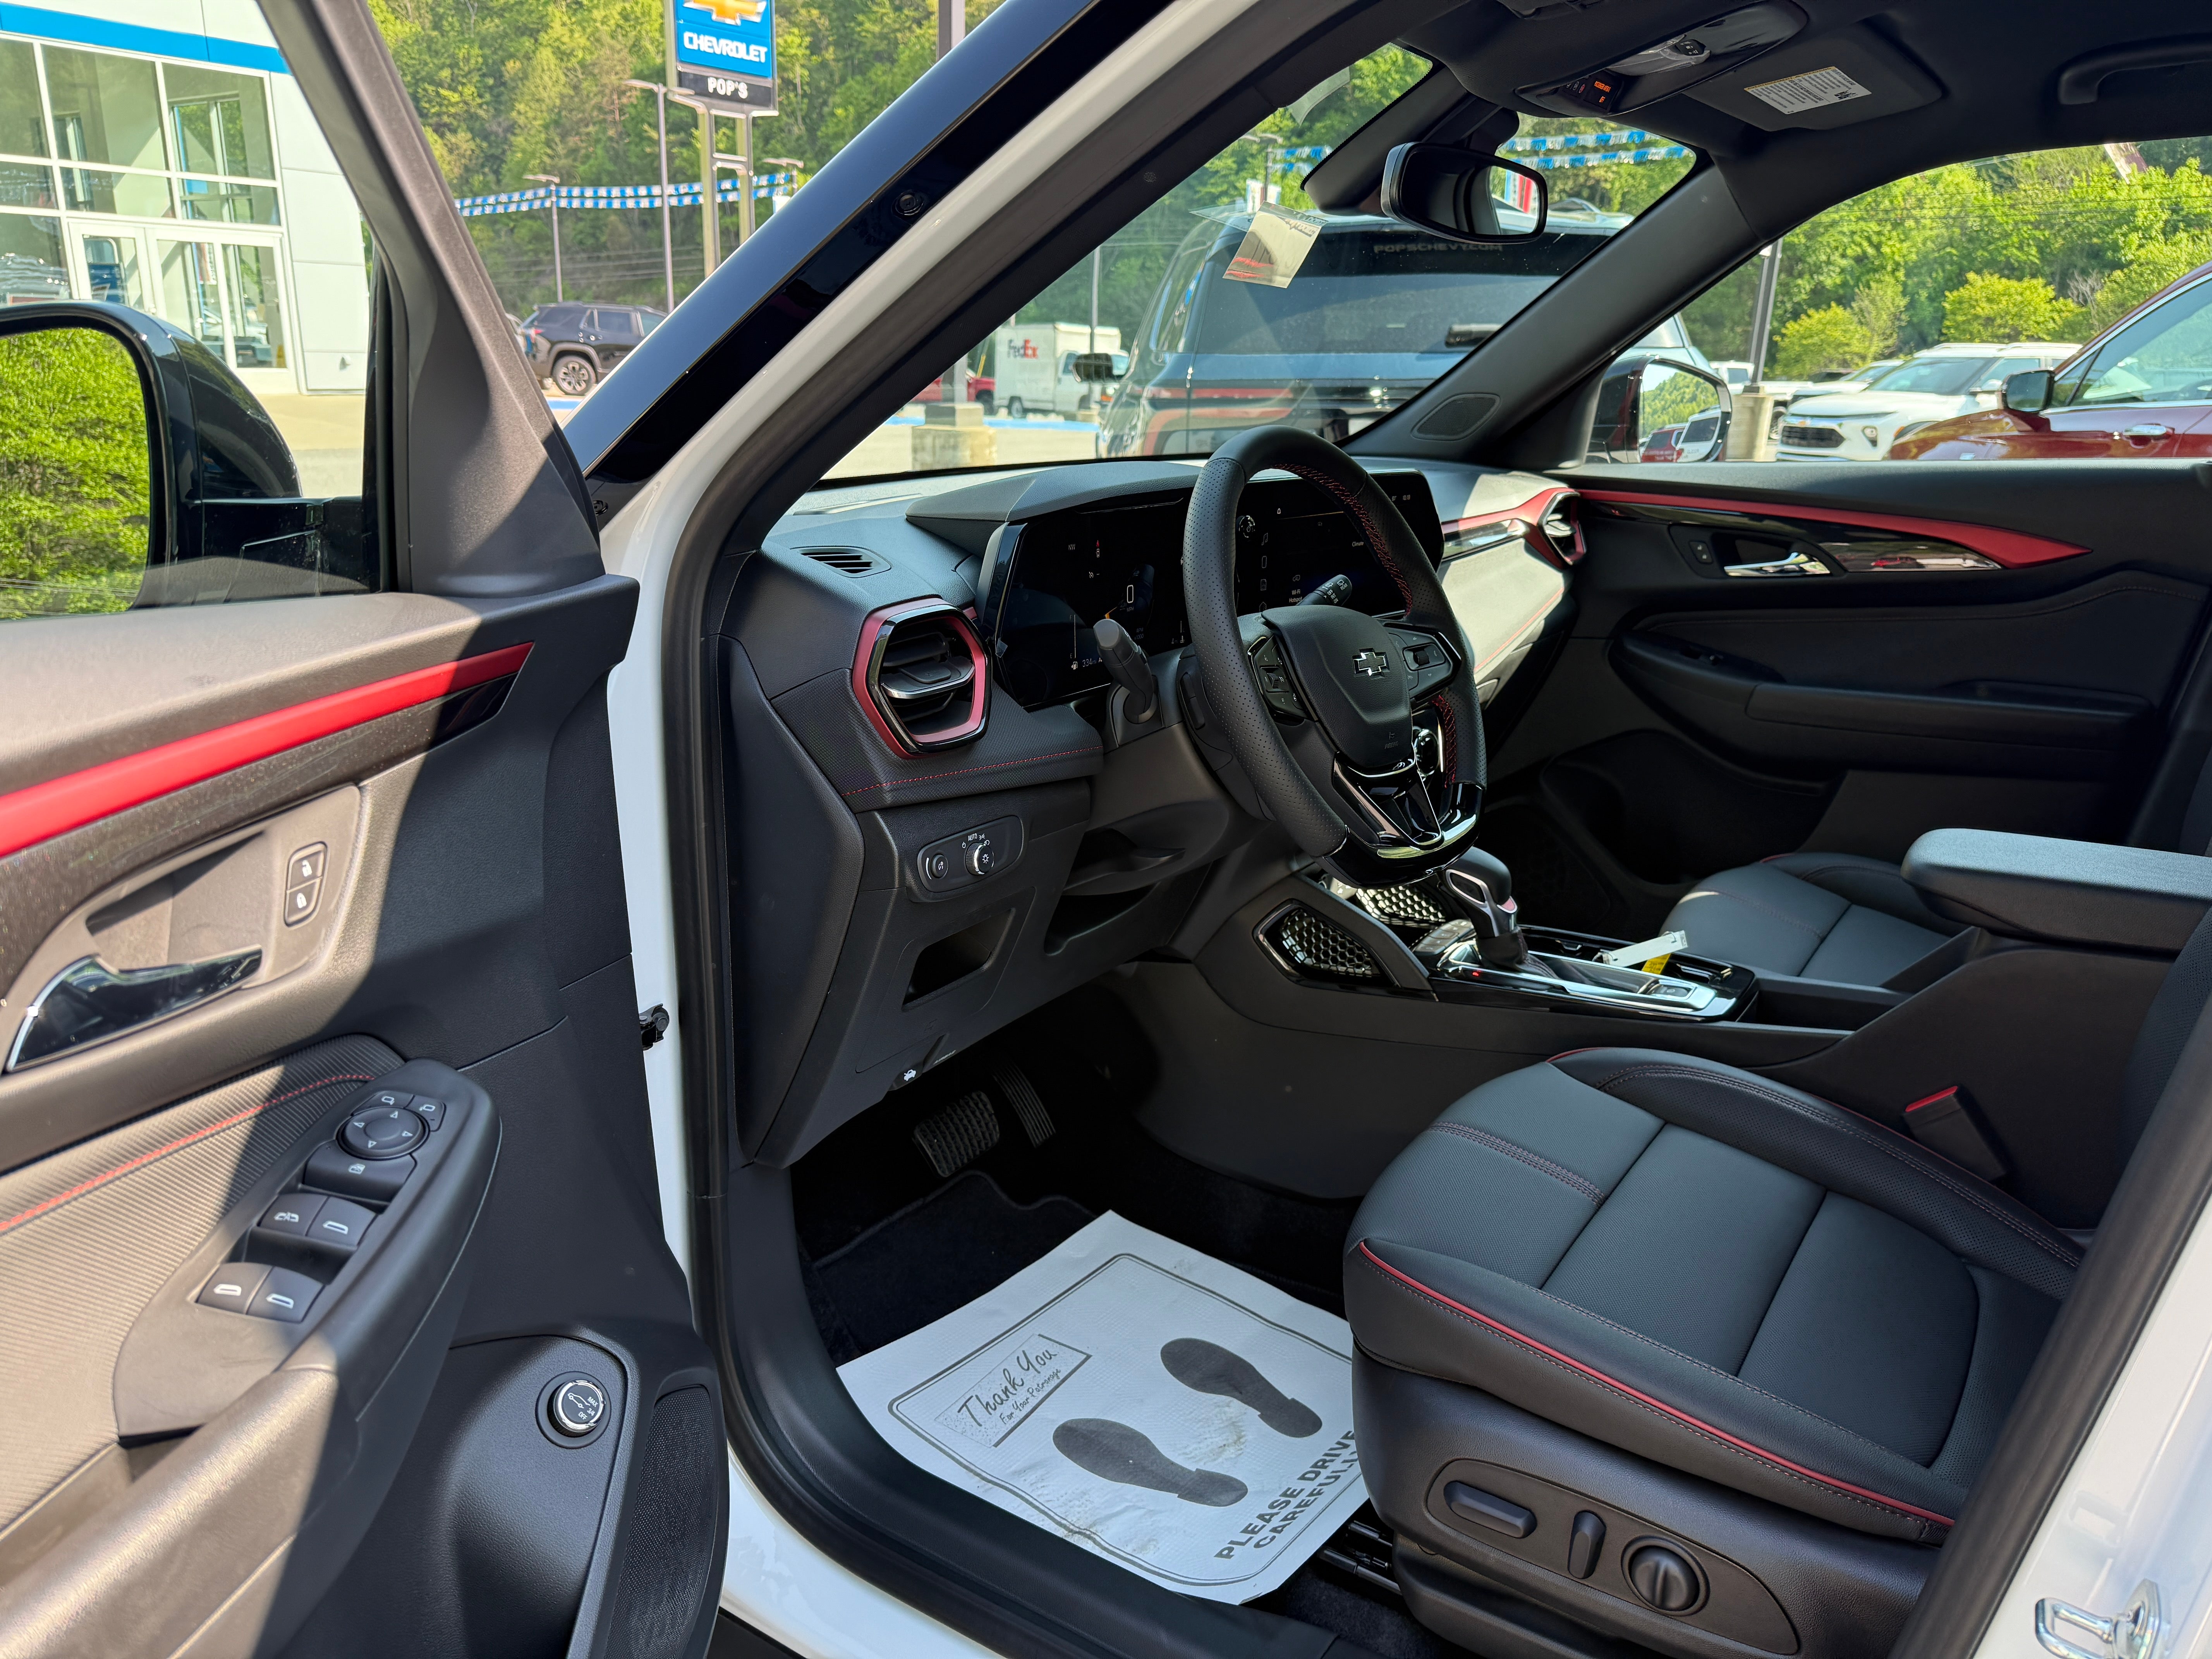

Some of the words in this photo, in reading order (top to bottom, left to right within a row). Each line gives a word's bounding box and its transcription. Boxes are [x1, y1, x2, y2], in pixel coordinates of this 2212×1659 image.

[684, 31, 768, 63] CHEVROLET
[708, 77, 748, 99] POP'S
[1007, 339, 1039, 359] FedEx
[1127, 584, 1134, 603] 0
[968, 833, 978, 842] AUTO
[957, 1368, 1025, 1427] Thank
[1017, 1350, 1058, 1374] You
[999, 1412, 1014, 1424] For
[1012, 1397, 1030, 1412] Your
[1027, 1368, 1061, 1398] Patronage
[587, 1396, 598, 1407] MAX
[587, 1408, 595, 1416] 3/4
[578, 1411, 587, 1420] OFF
[1213, 1487, 1305, 1559] PLEASE
[1297, 1431, 1355, 1481] DRIVE
[1253, 1451, 1358, 1549] CAREFULL
